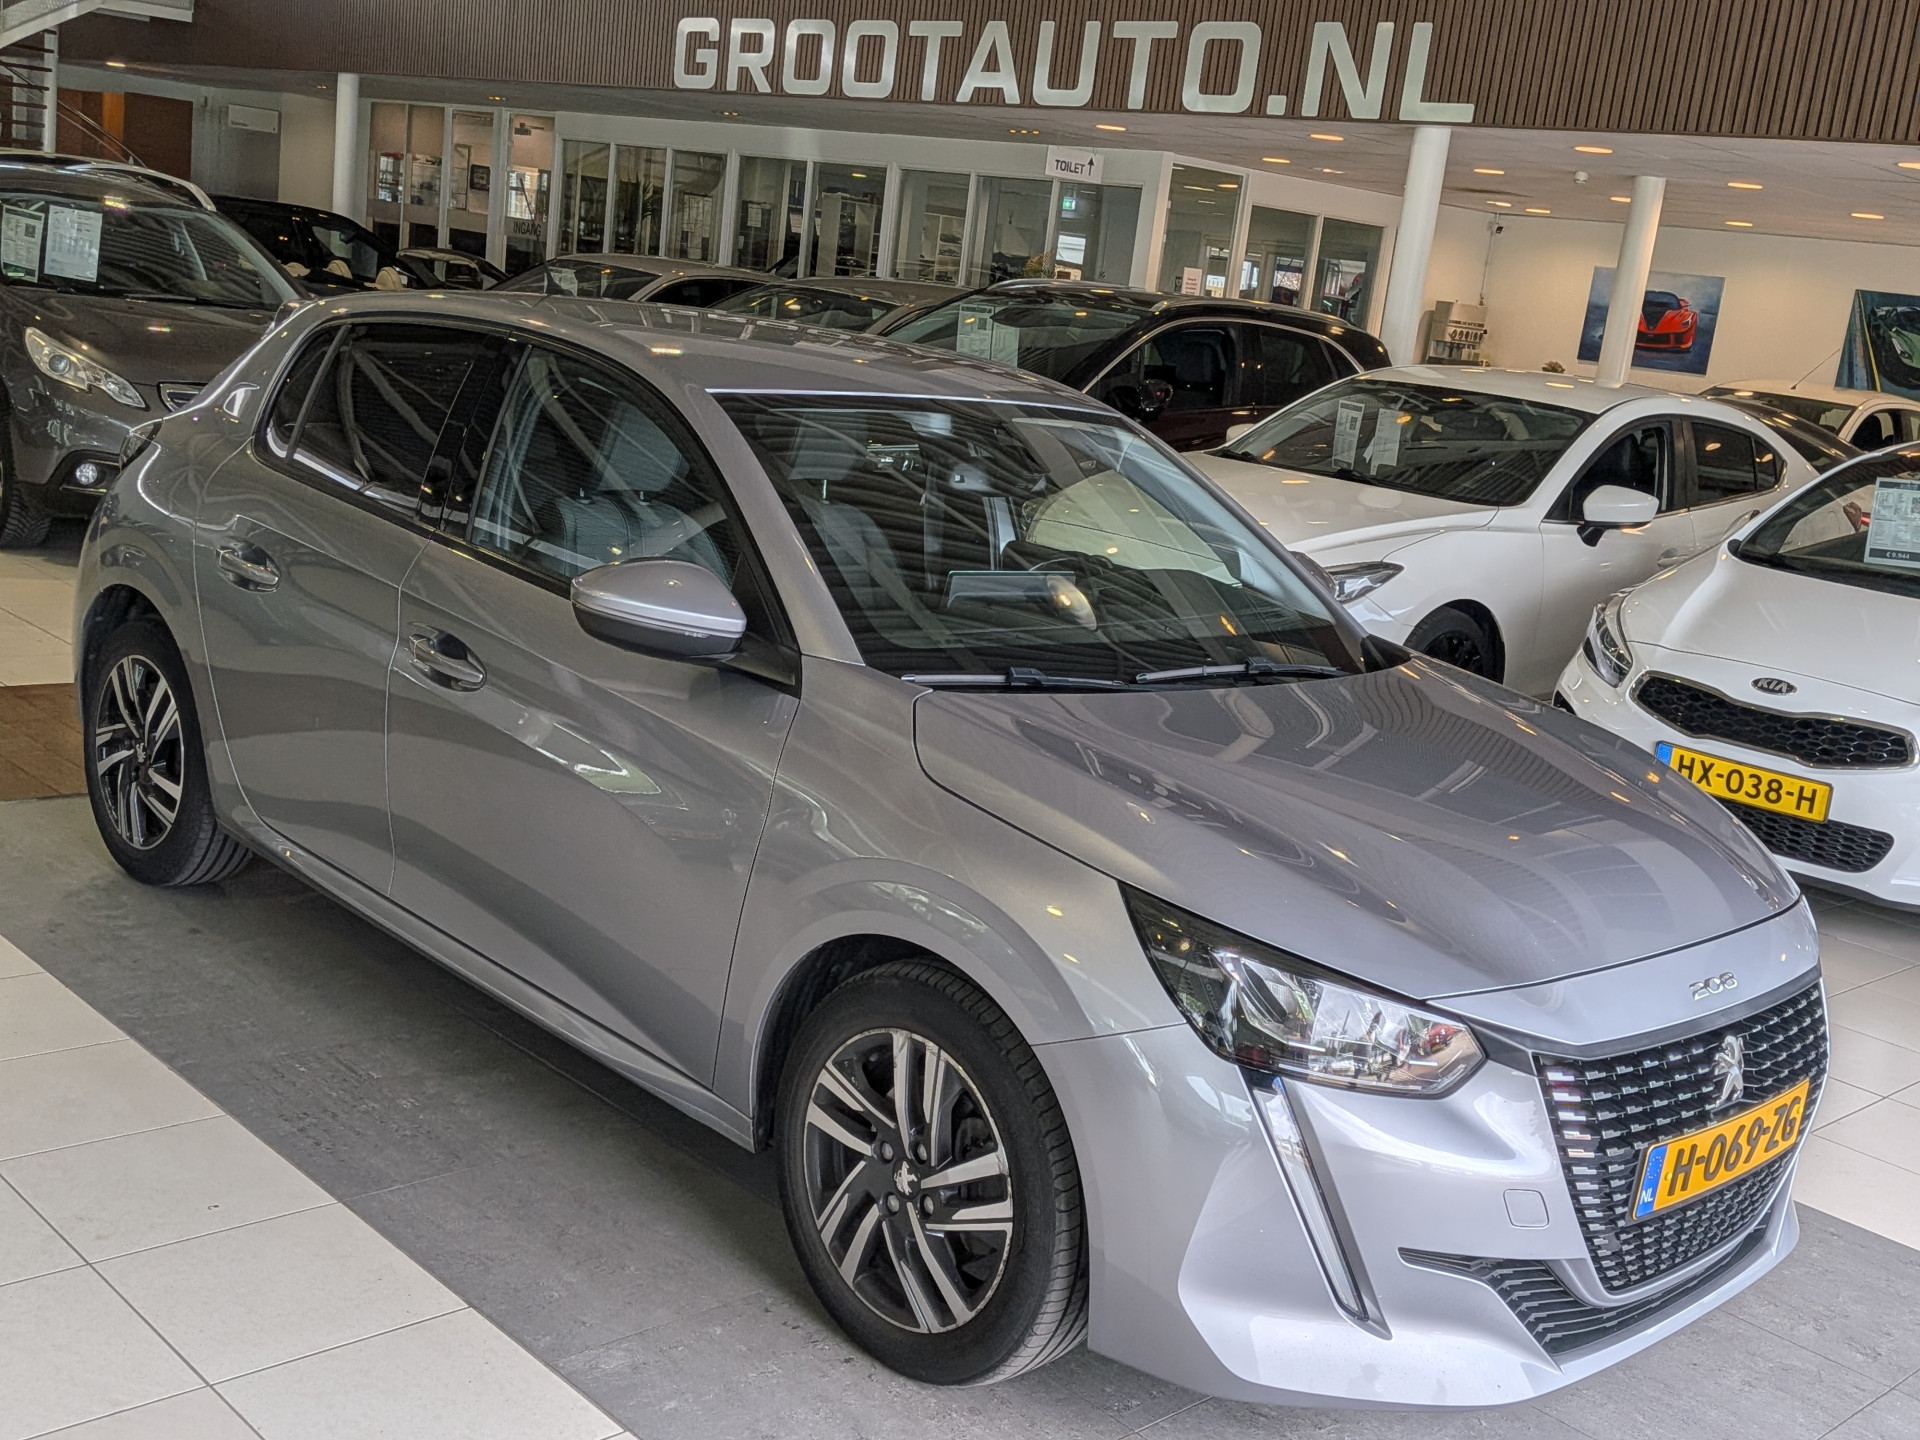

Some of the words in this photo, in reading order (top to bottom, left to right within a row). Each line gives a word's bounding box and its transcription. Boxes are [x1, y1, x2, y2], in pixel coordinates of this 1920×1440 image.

[673, 17, 1475, 123] GROOTAUTO.NL
[1055, 159, 1085, 175] TOILET
[513, 221, 541, 237] INGANG
[1757, 678, 1788, 693] KIA
[1677, 754, 1818, 814] HX-038-H
[1688, 971, 1738, 1001] 208
[1640, 1187, 1654, 1205] NL
[1667, 1096, 1802, 1197] H-069-ZG
